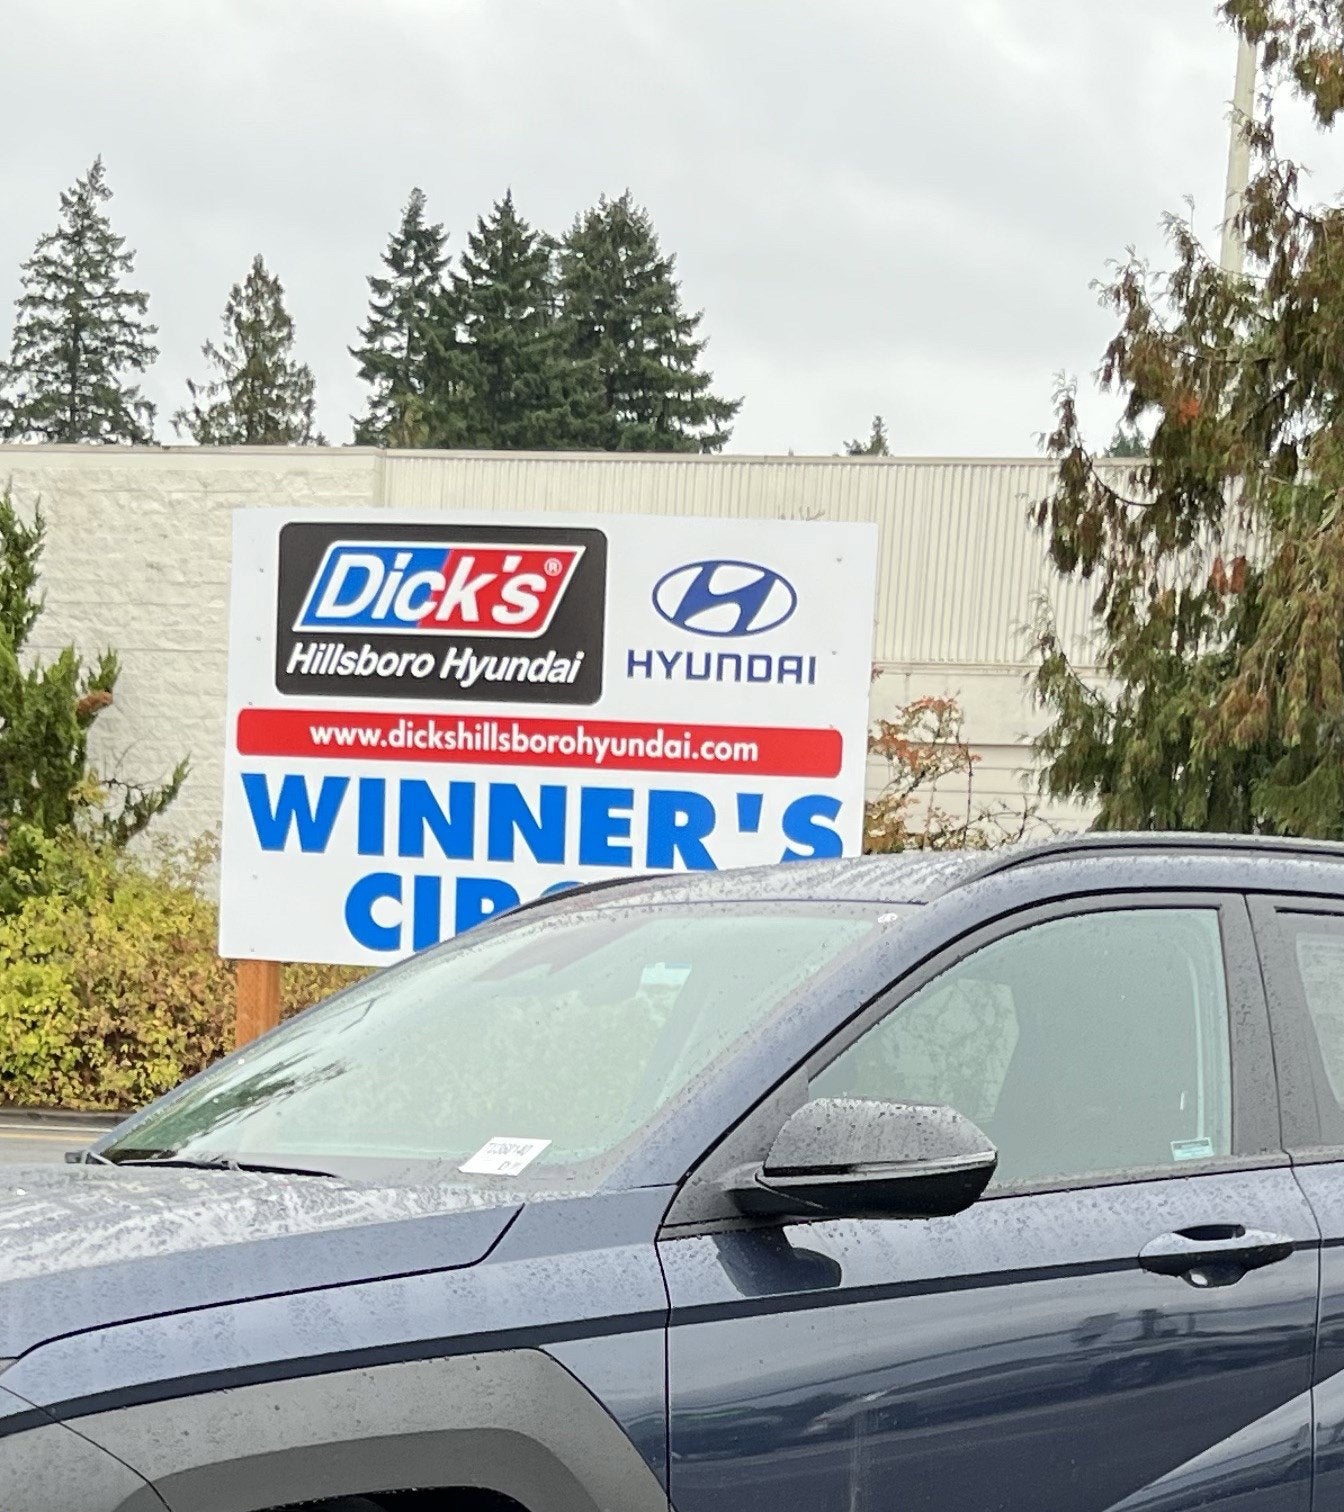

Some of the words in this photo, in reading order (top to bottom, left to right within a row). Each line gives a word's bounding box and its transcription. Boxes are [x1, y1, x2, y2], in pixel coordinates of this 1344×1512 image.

[315, 552, 547, 625] Dick's
[286, 642, 435, 678] Hillsboro
[440, 647, 585, 688] Hyundai
[627, 649, 816, 685] HYUNDAI
[310, 720, 759, 763] www.dickshillsborohyundai.com
[241, 773, 844, 872] WINNER'S
